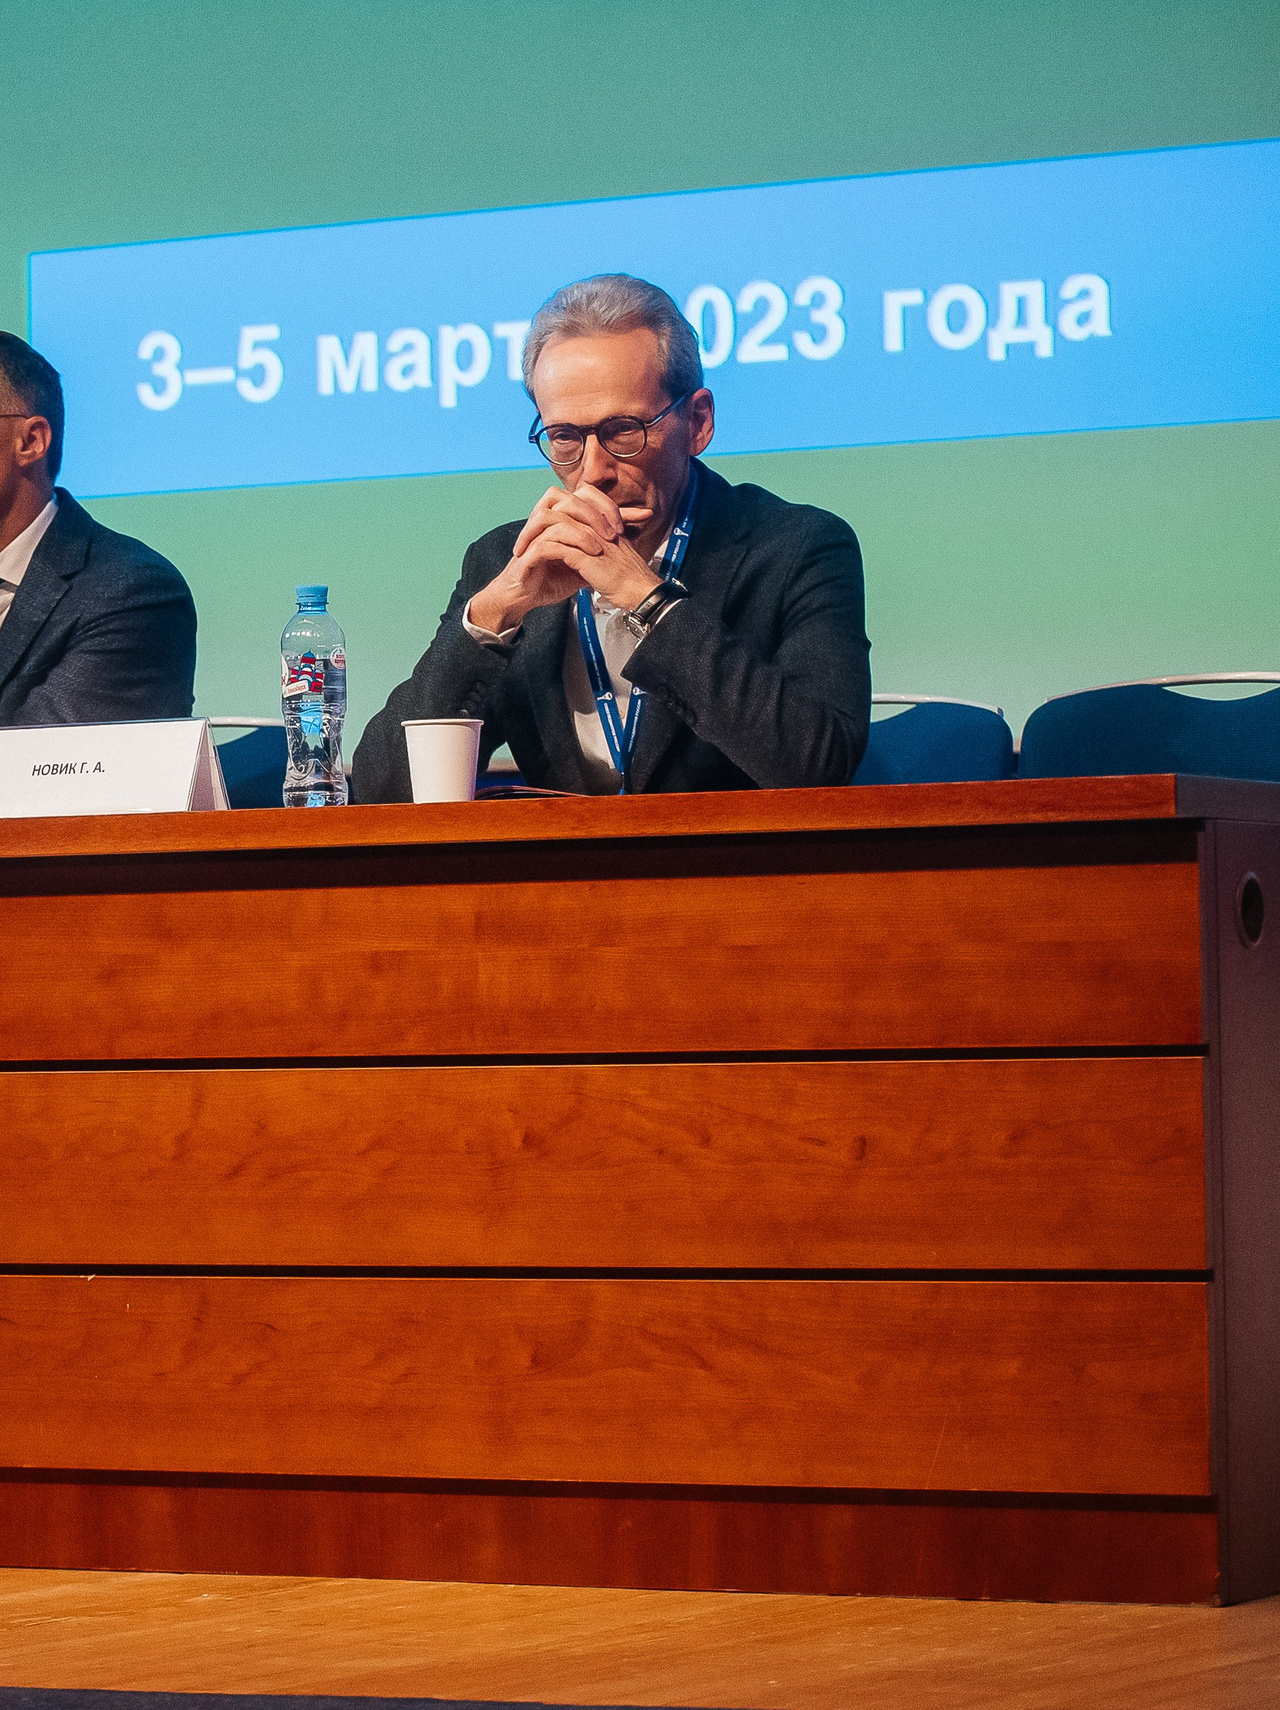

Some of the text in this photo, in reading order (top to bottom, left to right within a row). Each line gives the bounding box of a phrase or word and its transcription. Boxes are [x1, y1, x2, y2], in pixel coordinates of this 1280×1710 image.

[316, 318, 532, 408] март
[685, 275, 847, 370] 023
[882, 273, 1113, 362] года
[31, 761, 106, 777] НОВИК Г. А.
